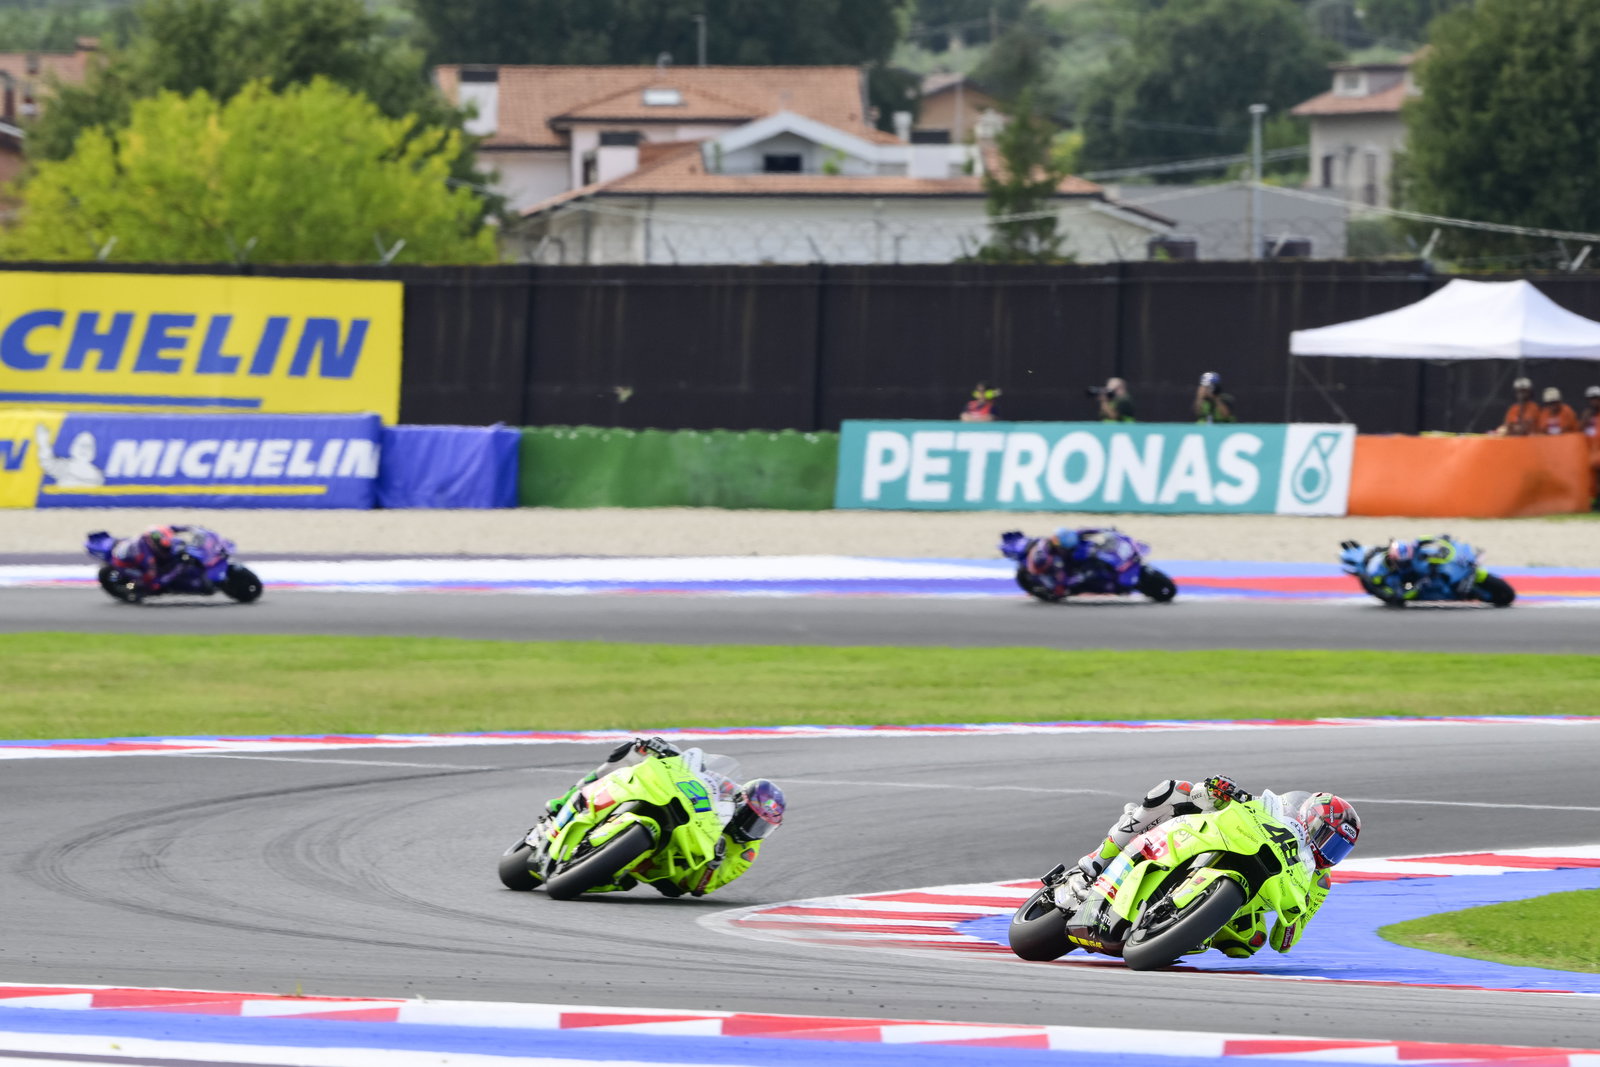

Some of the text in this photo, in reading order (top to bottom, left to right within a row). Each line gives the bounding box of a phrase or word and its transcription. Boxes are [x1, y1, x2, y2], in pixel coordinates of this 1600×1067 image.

[104, 439, 381, 478] MICHELIN
[861, 430, 1263, 505] PETRONAS
[676, 780, 712, 813] 21
